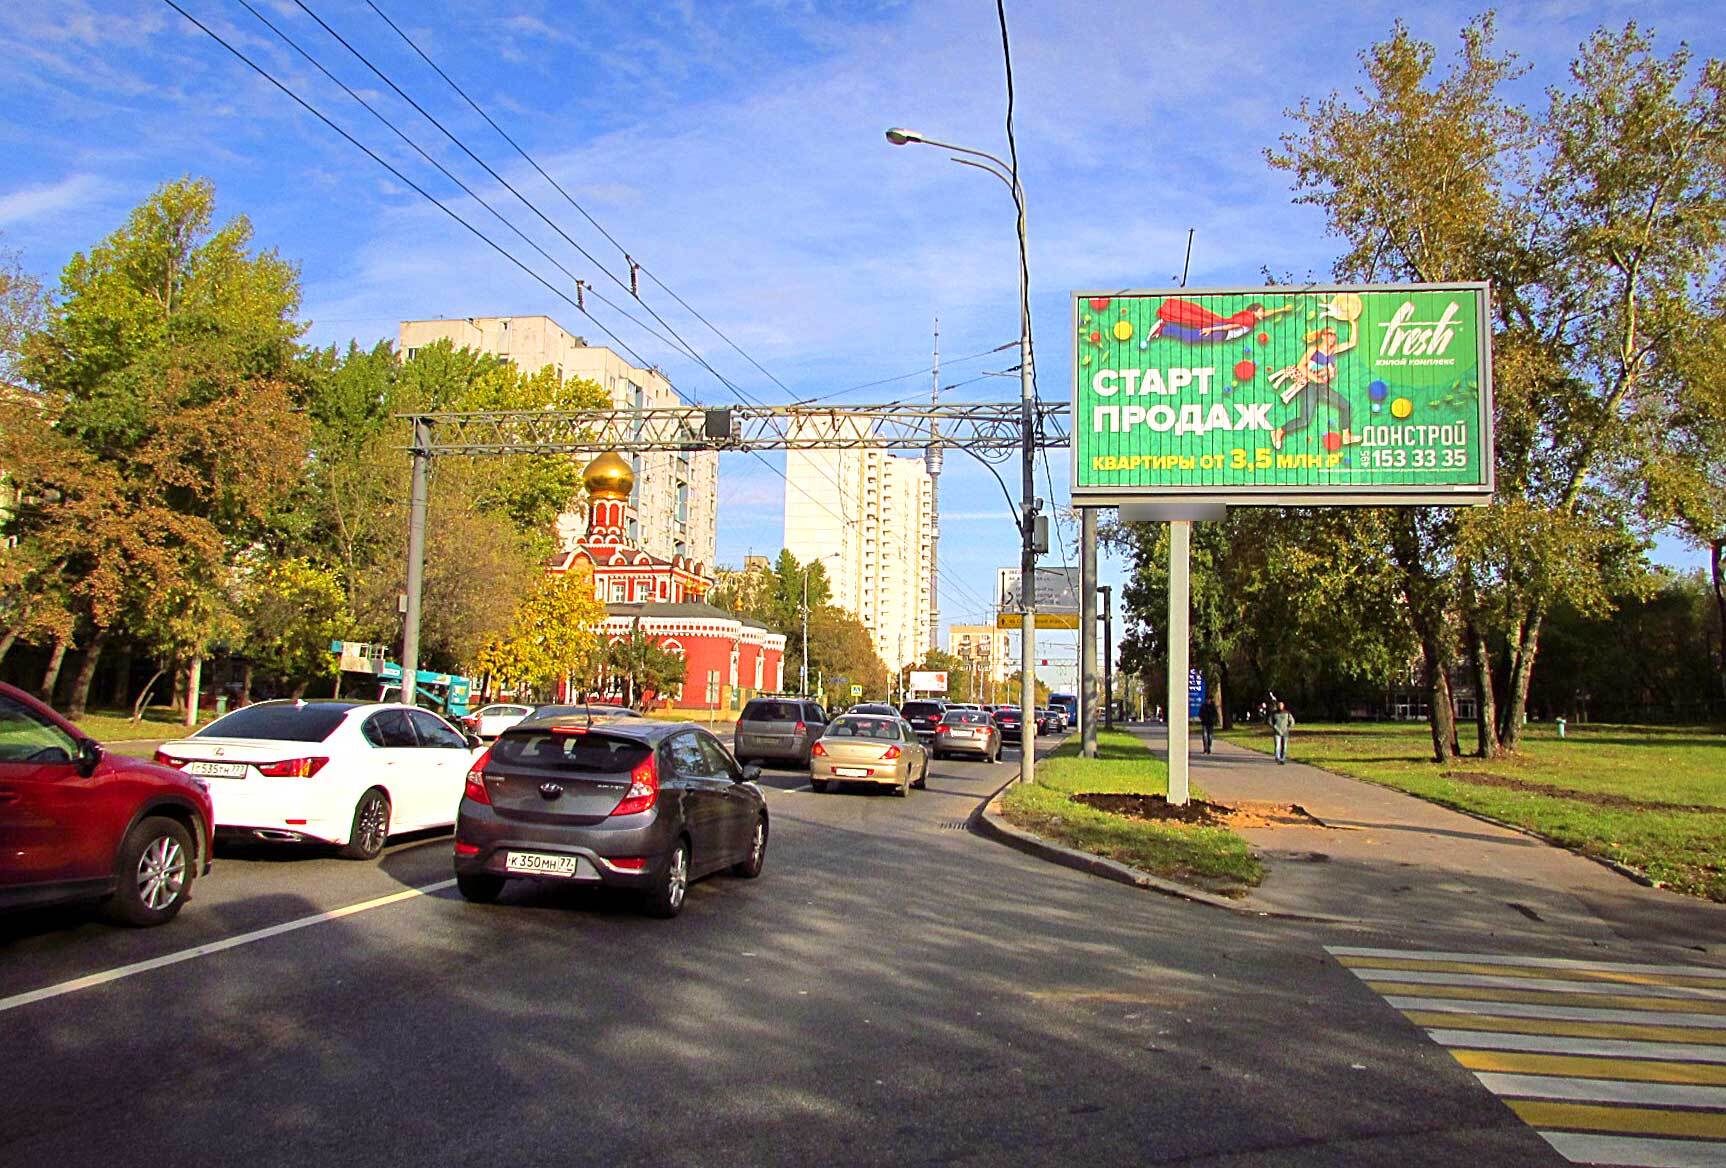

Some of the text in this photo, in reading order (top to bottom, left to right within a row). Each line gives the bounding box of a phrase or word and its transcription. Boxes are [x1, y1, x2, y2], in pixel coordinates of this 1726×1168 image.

[1377, 301, 1463, 357] fresh
[1092, 367, 1216, 397] СТАРТ
[1093, 402, 1274, 436] ПРОДАЖ
[1361, 420, 1467, 447] ДОНСТРОЙ
[1093, 455, 1195, 471] КВАРТИРЫ
[1200, 454, 1225, 469] ОТ
[1230, 448, 1272, 473] 3,5
[1276, 454, 1322, 469] МЛН
[1359, 448, 1467, 468] 495 153 33 35
